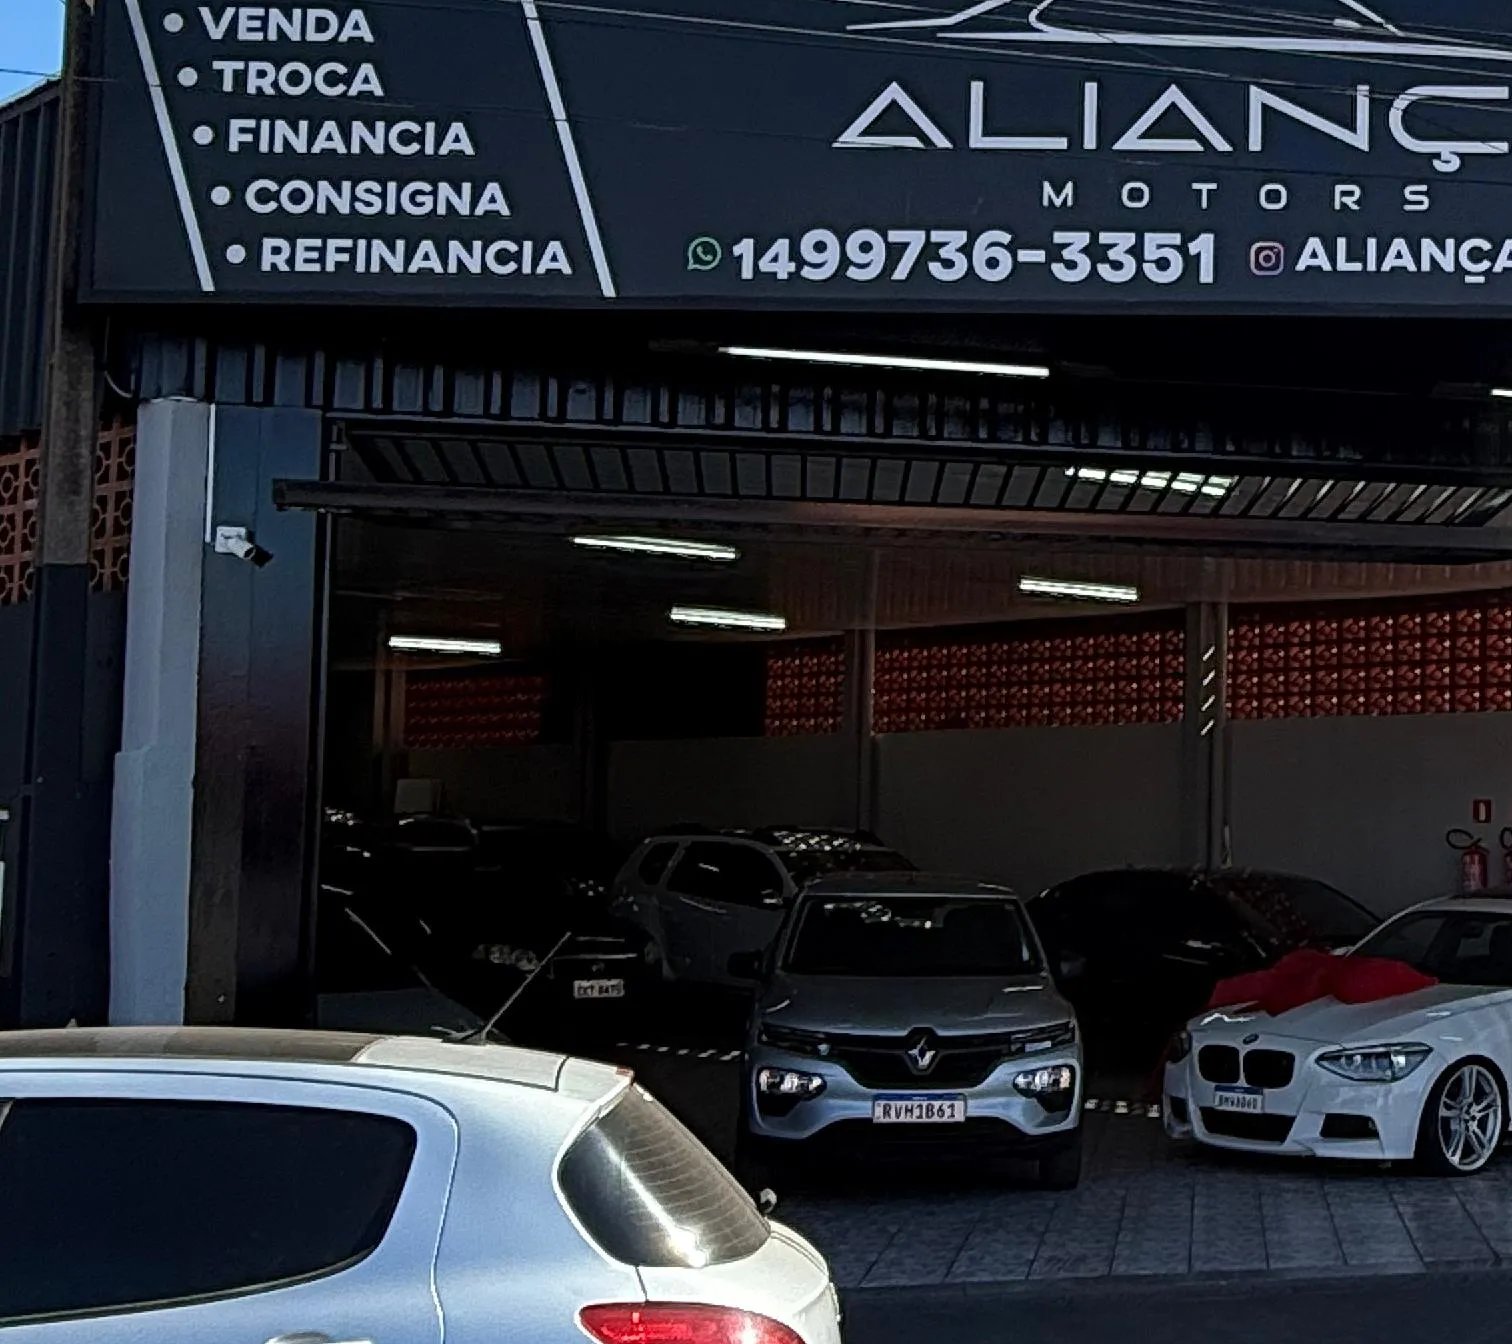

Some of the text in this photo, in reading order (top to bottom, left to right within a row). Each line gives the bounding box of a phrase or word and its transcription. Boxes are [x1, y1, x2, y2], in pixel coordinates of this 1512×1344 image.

[200, 6, 374, 43] VENDA
[212, 60, 385, 97] TROCA
[227, 119, 475, 157] FINANCIA
[244, 179, 511, 218] CONSIGNA
[1042, 180, 1430, 212] MOTORS
[260, 237, 573, 276] REFINANCIA
[732, 228, 1215, 285] 1499736-3351
